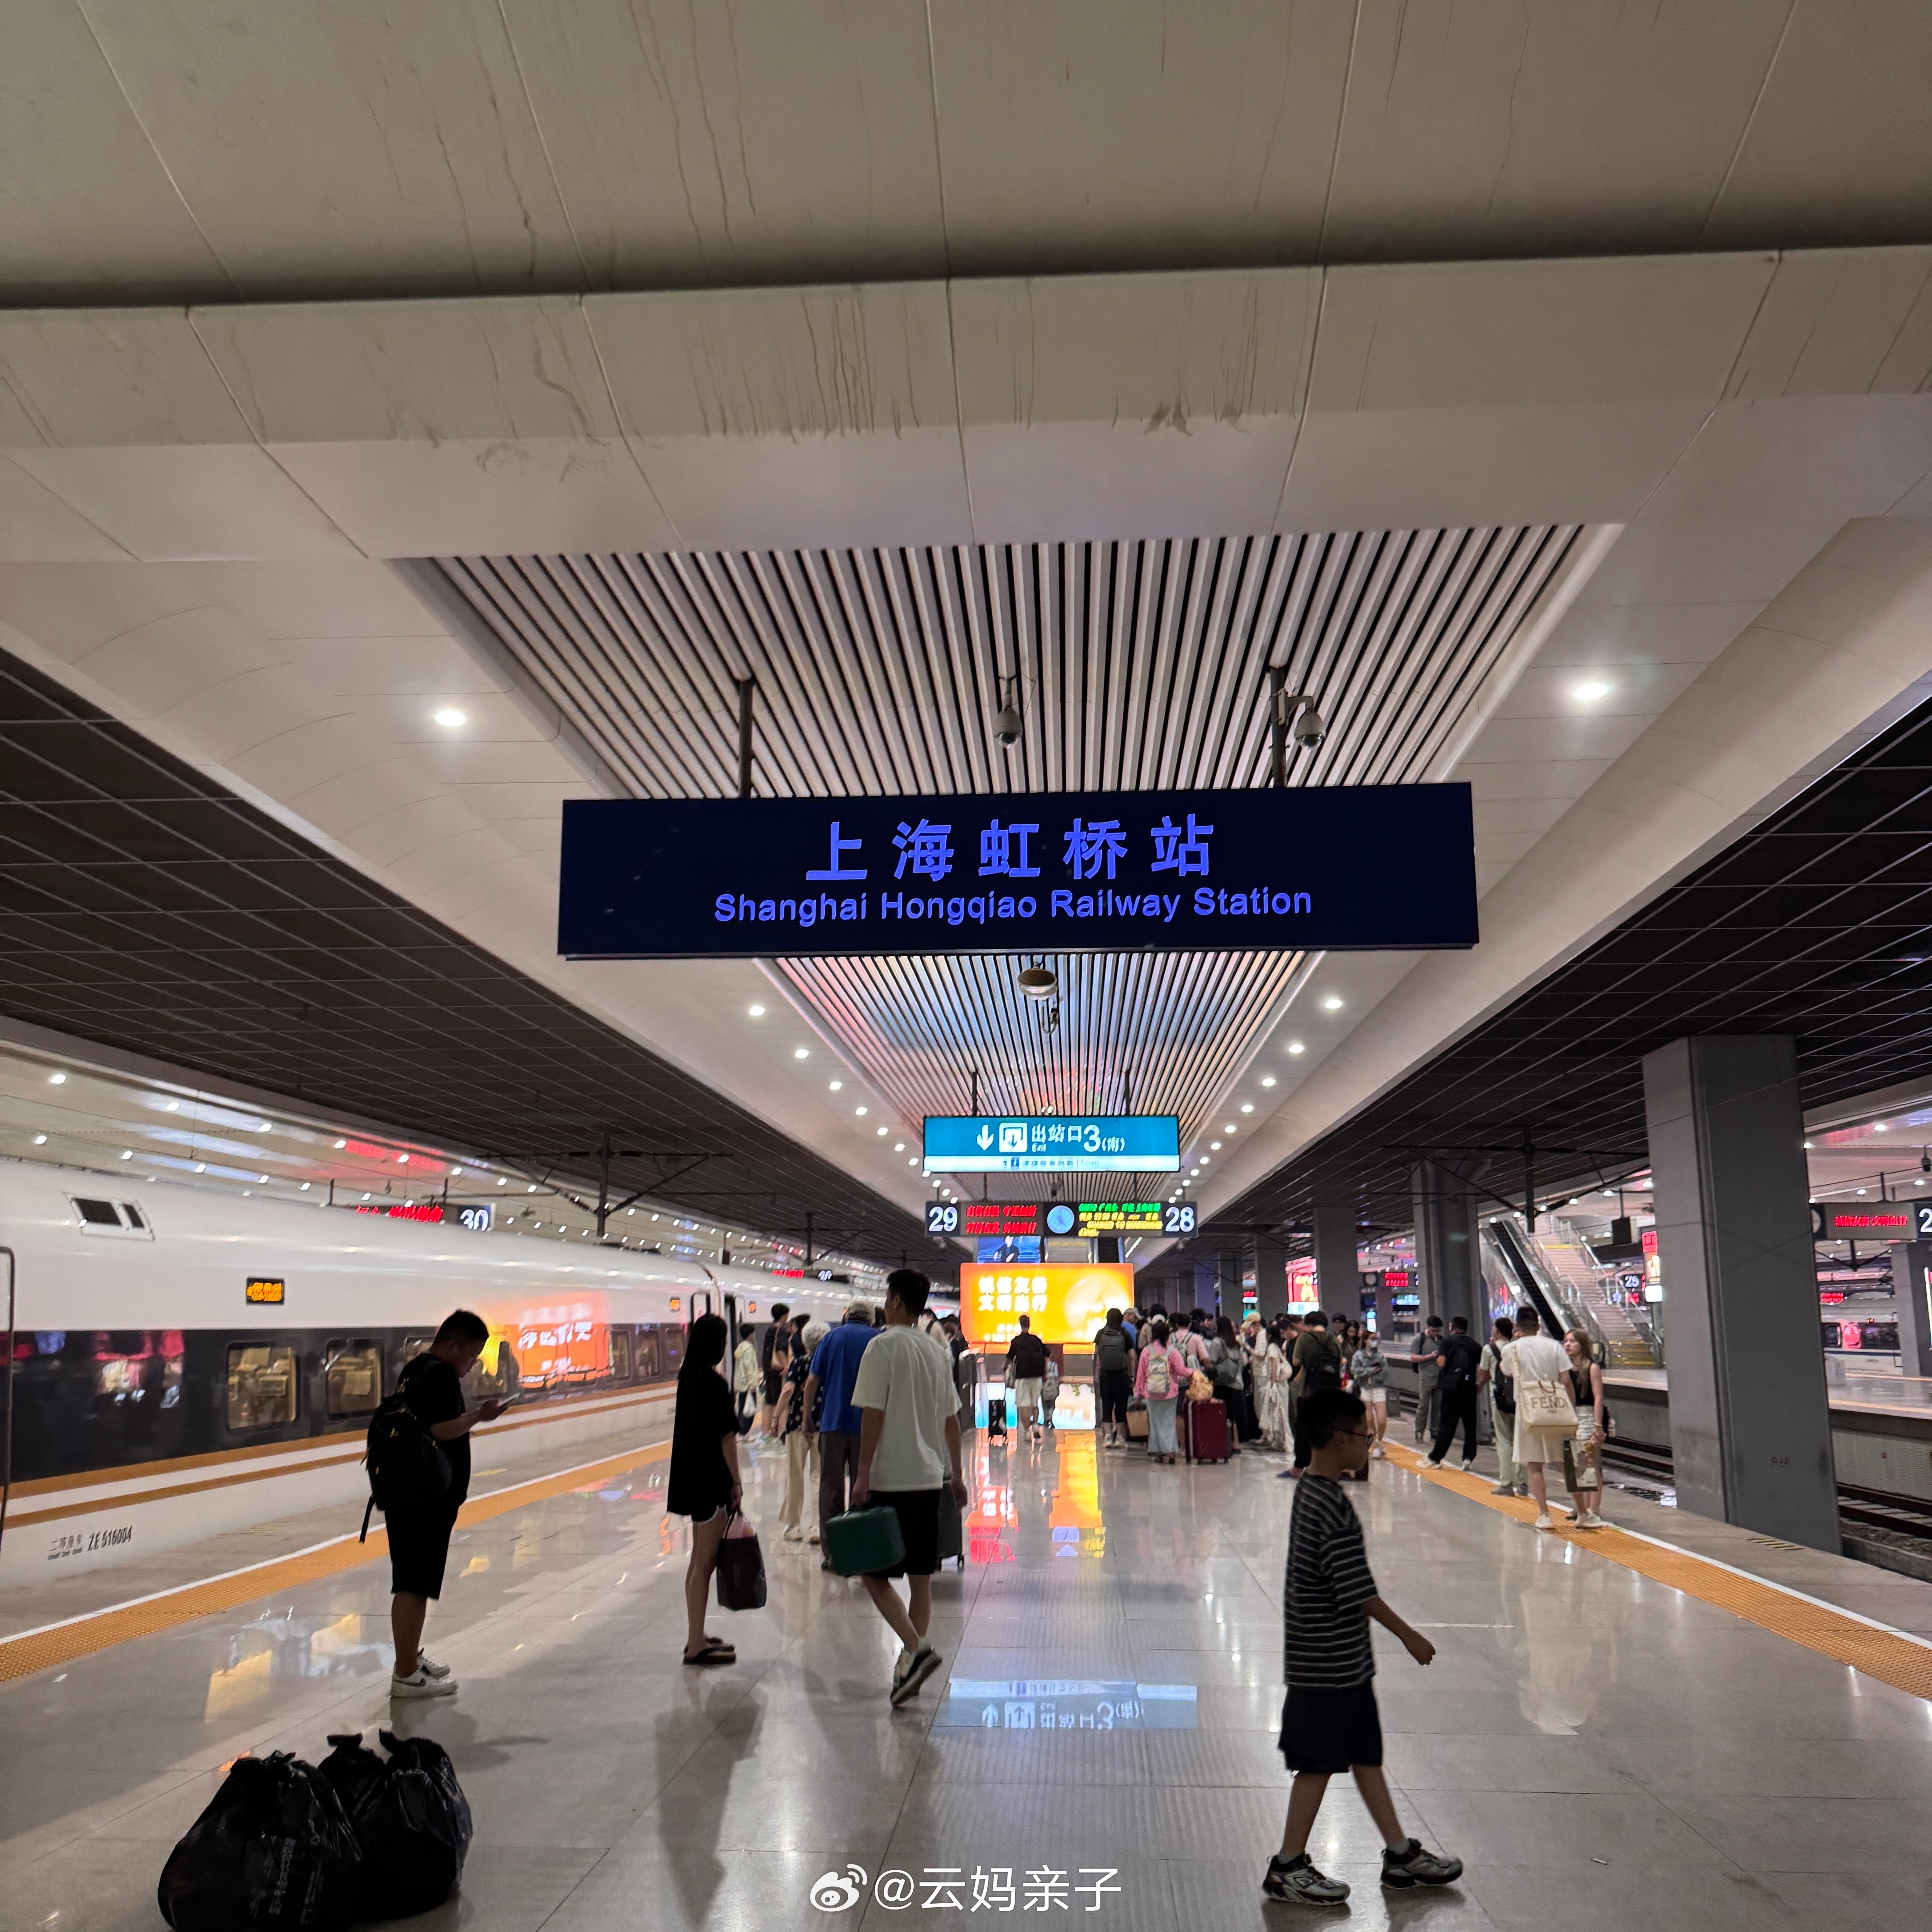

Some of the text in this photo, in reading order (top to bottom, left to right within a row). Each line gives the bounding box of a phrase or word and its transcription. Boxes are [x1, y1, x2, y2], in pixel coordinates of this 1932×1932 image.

[805, 814, 1214, 882] 上海虹桥站
[714, 887, 1311, 927] Shanghai Hongqiao Railway Station
[929, 1206, 958, 1232] 29
[1165, 1206, 1195, 1232] 28
